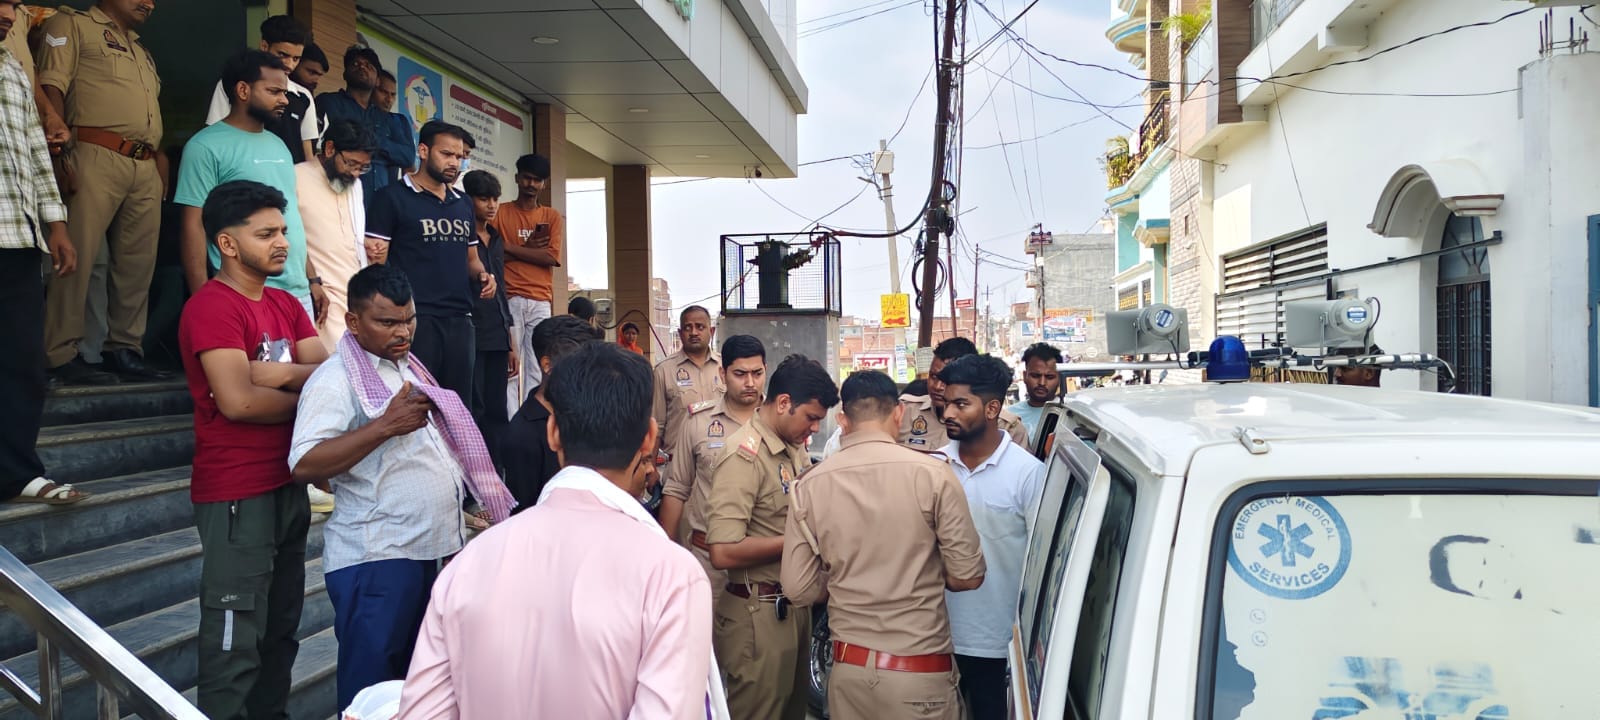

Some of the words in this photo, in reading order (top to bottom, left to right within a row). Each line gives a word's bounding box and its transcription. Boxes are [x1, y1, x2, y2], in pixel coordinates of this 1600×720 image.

[420, 218, 470, 237] BOSS
[1295, 498, 1336, 540] MEDICAL
[1249, 561, 1330, 587] SERVICES
